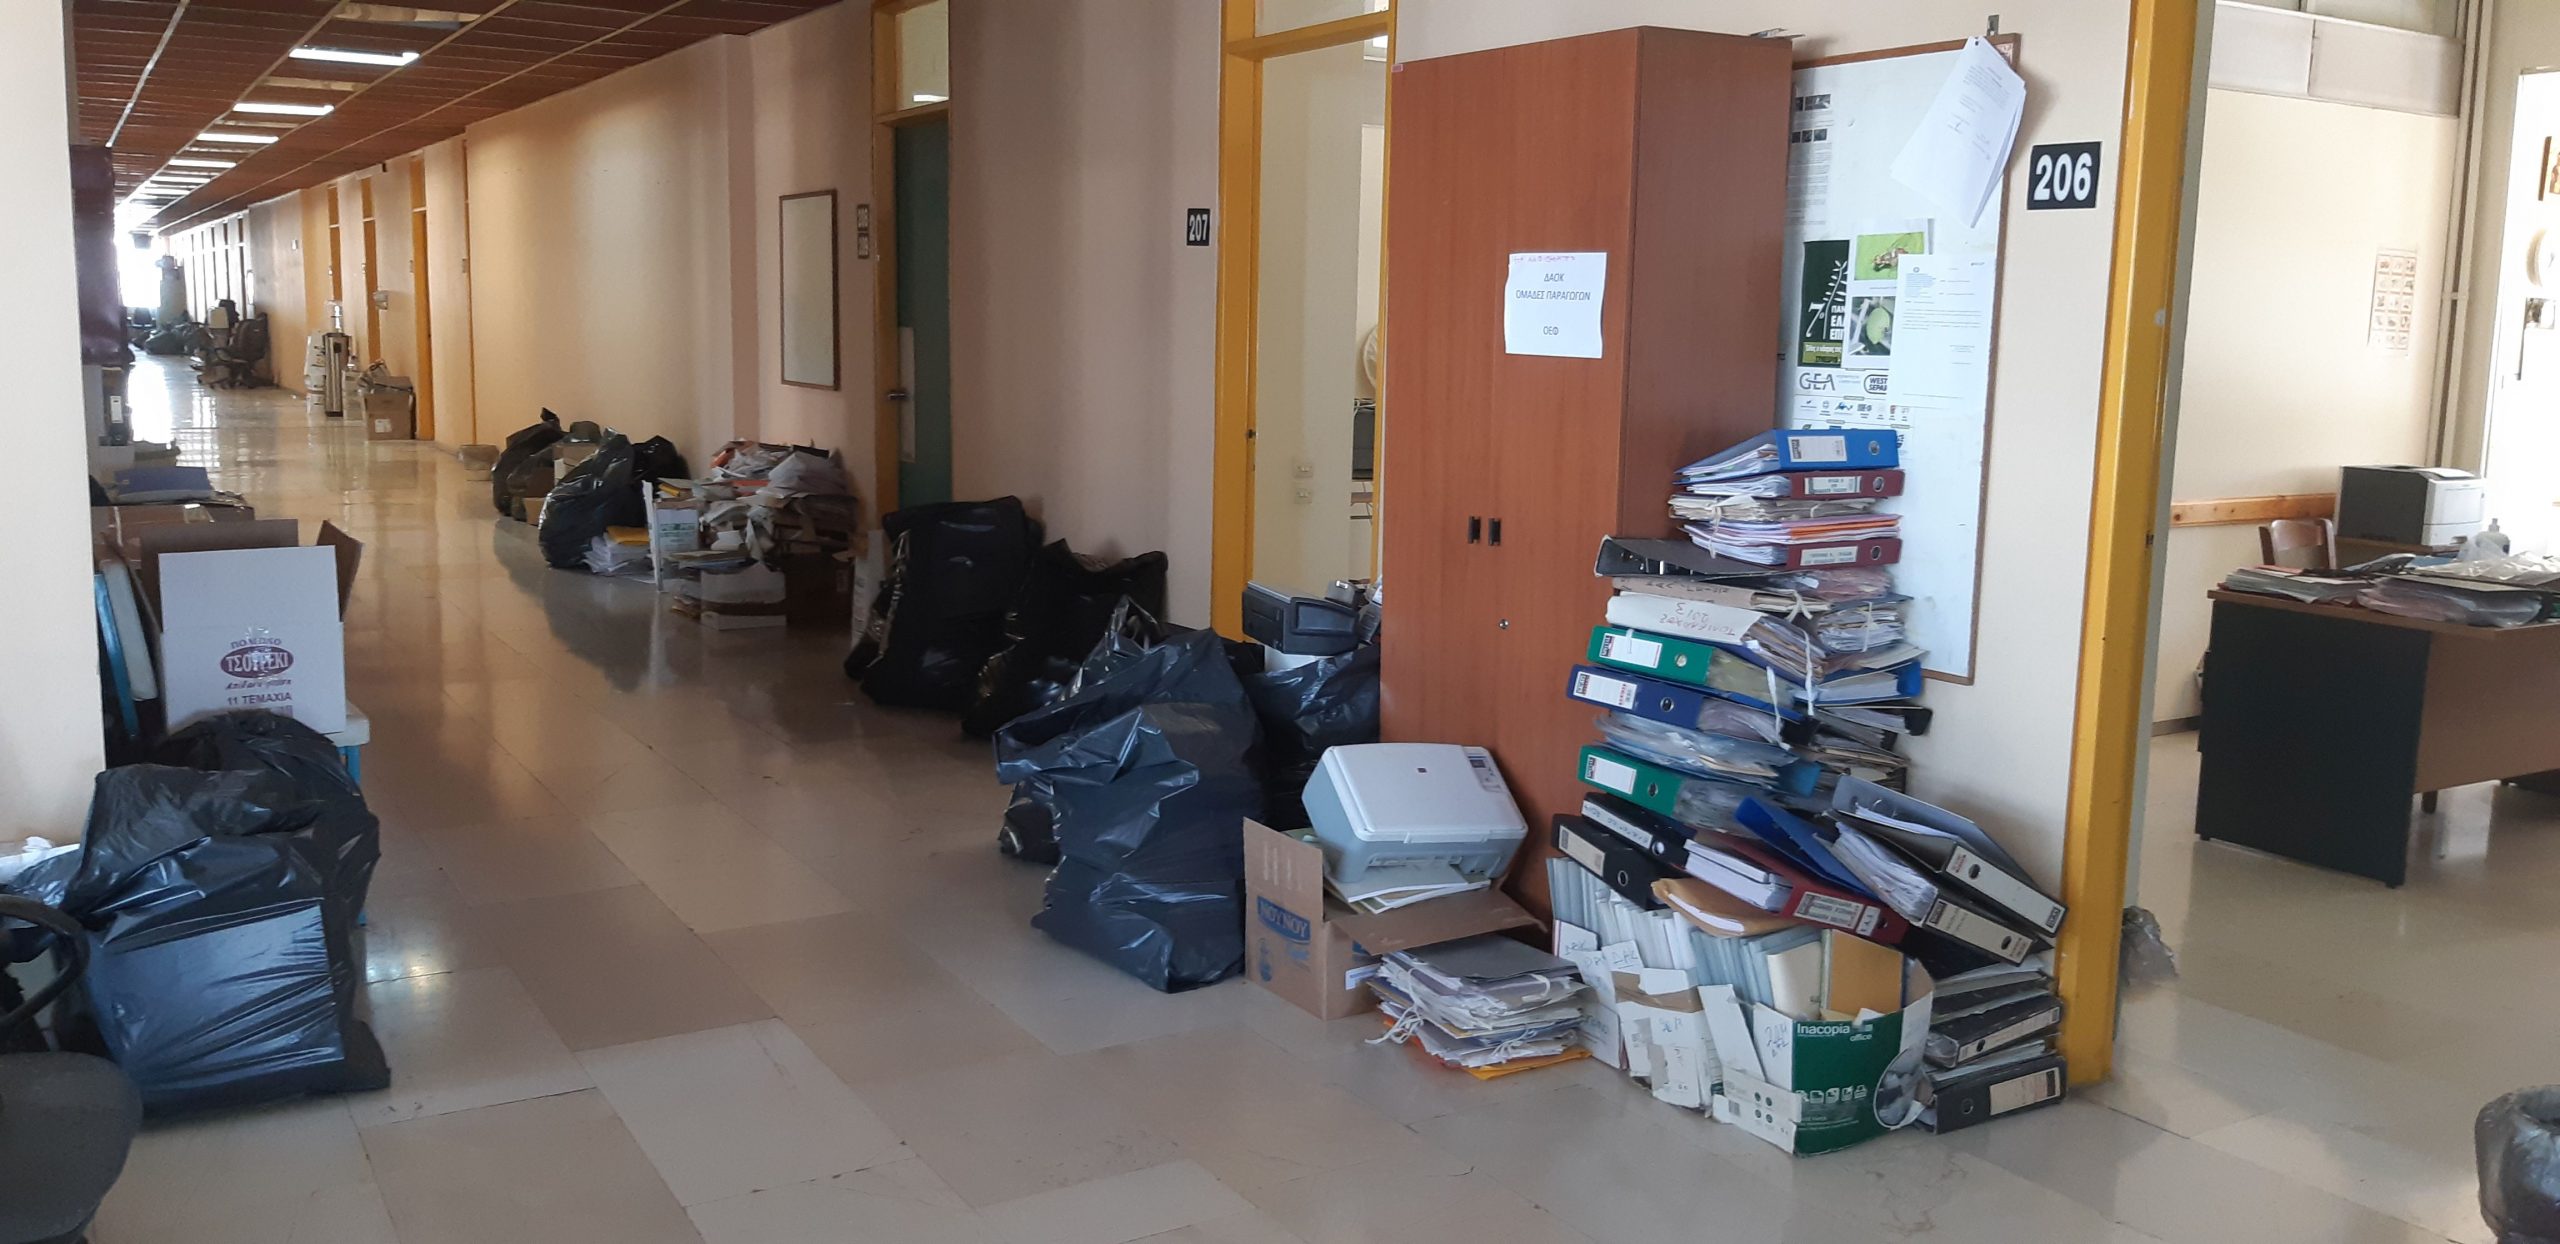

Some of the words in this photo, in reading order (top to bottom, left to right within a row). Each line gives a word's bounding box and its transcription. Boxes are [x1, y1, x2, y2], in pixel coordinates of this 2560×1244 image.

[2033, 152, 2093, 202] 206
[1189, 213, 1209, 242] 207
[1543, 273, 1565, 282] ΔΑΟΚ
[1515, 289, 1545, 300] ΟΜΑΔΕΣ
[1546, 290, 1591, 301] ΠΑΡΑΓΩΓΩΝ
[1799, 372, 1836, 391] GEA
[241, 692, 292, 704] ΤΕΜΑΧΙΑ
[1797, 1023, 1851, 1037] Inacopia
